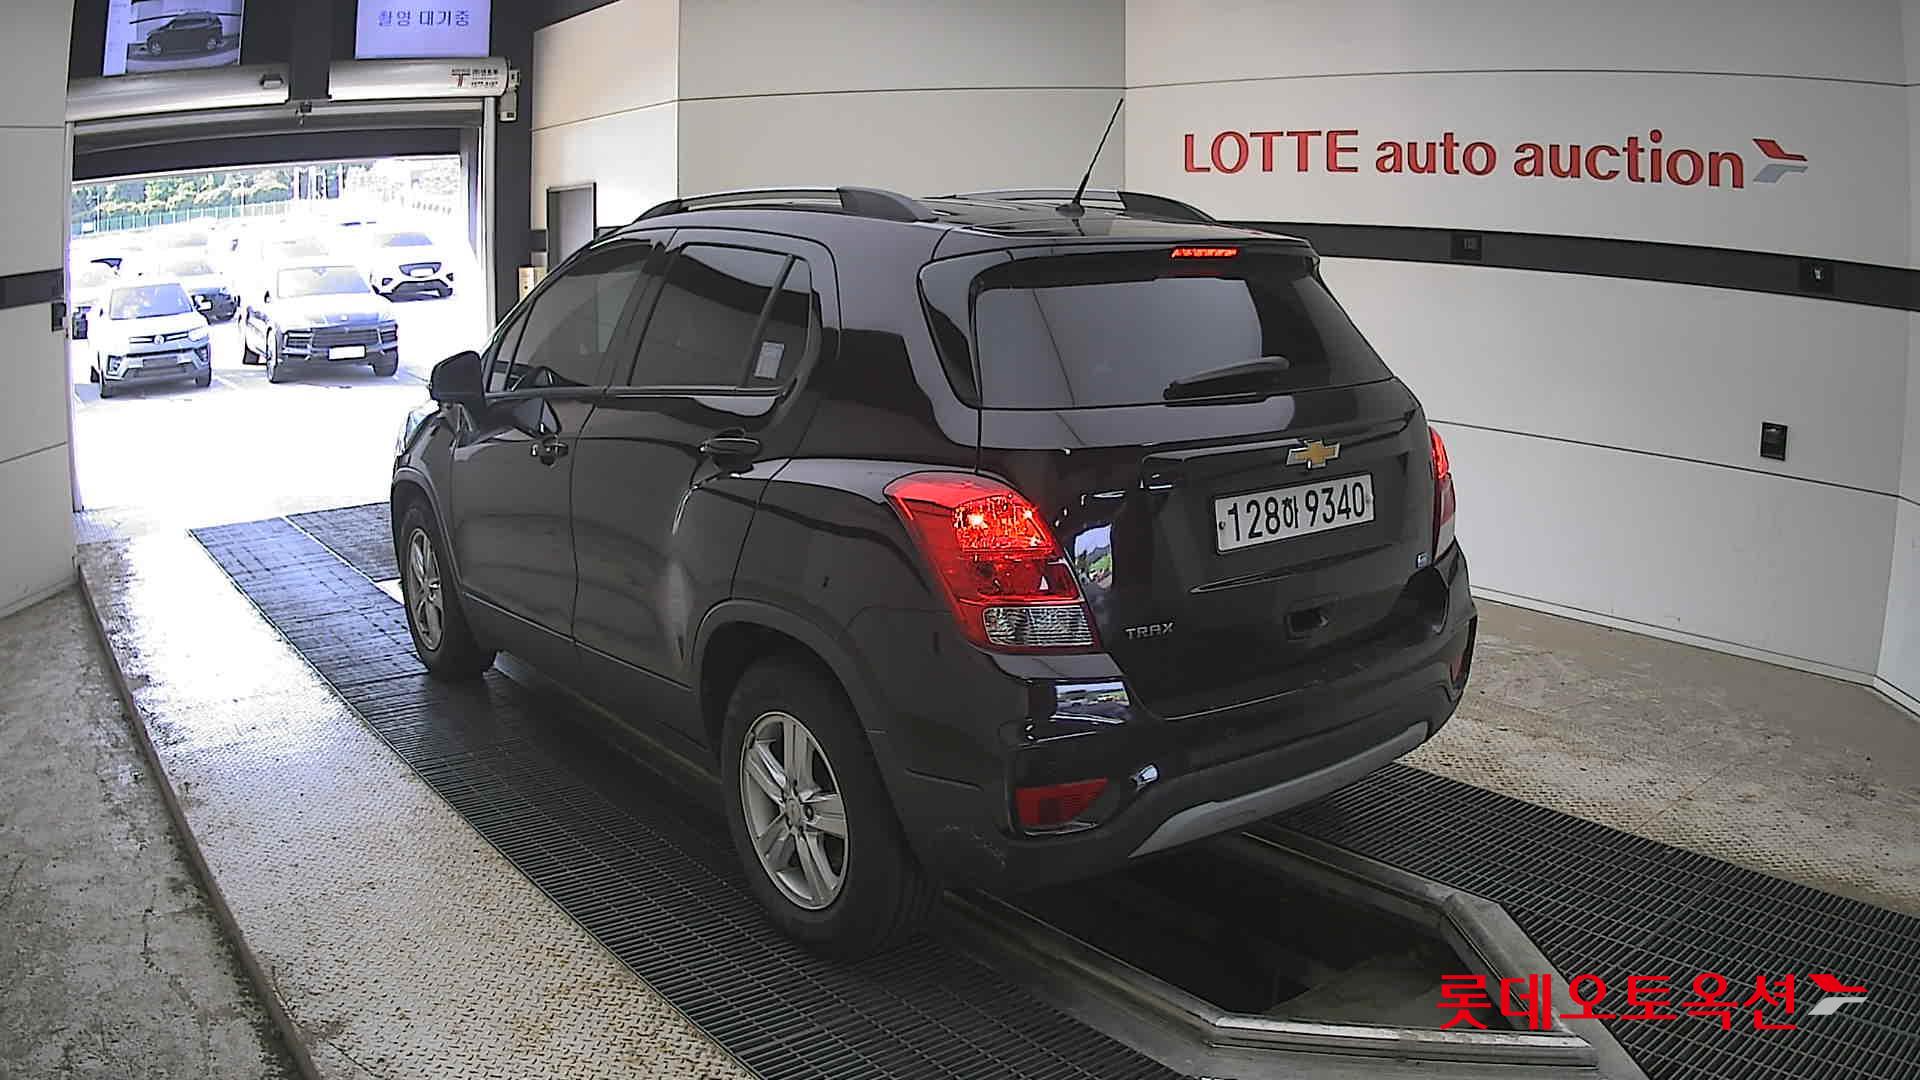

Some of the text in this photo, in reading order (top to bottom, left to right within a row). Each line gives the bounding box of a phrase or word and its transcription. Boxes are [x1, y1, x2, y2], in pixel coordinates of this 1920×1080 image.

[419, 9, 470, 27] 대기중
[1184, 129, 1744, 189] LOTTE auto auction
[1305, 481, 1365, 527] 9340
[1125, 622, 1173, 640] TRAX
